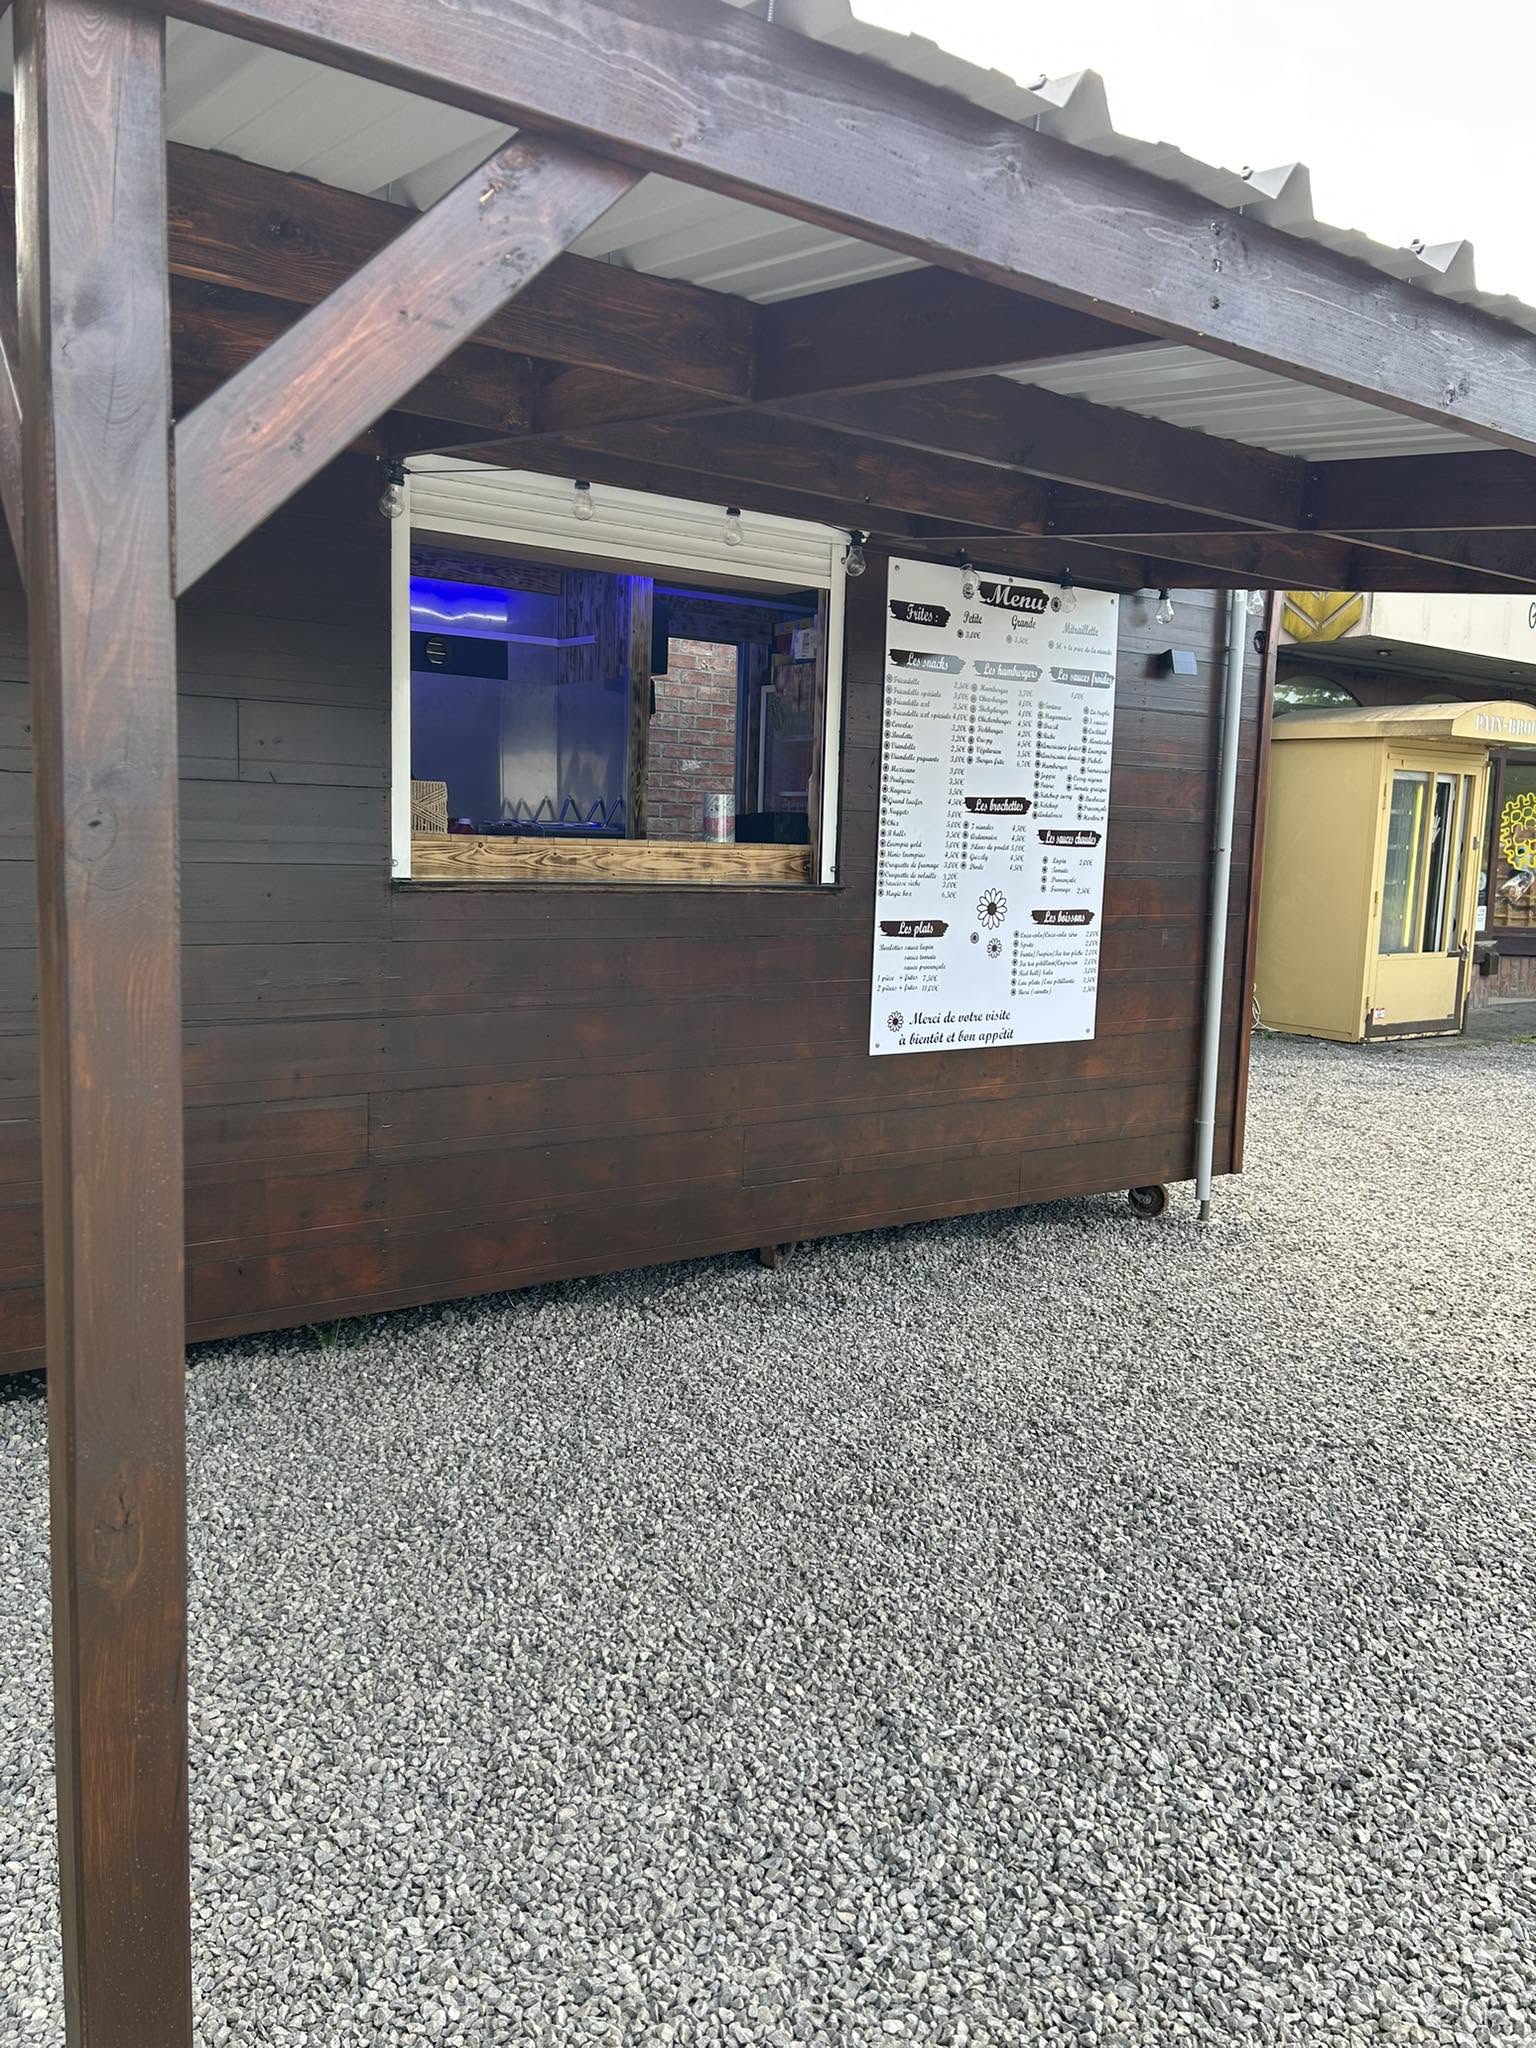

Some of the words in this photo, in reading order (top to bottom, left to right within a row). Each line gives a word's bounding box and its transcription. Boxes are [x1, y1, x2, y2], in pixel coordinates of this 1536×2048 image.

[987, 585, 1044, 610] Menu
[906, 604, 933, 622] Frites
[963, 611, 982, 624] Petite
[1011, 615, 1036, 631] Grande
[966, 631, 981, 639] 3,00€
[906, 653, 921, 667] Les
[922, 657, 948, 670] snacks
[983, 663, 996, 675] Les
[997, 664, 1039, 683] hamburgers
[1057, 670, 1069, 681] Les
[1070, 673, 1090, 683] sauces
[1091, 671, 1114, 687] froides
[890, 808, 909, 817] Nuggets
[975, 799, 988, 811] Les
[990, 799, 1023, 811] brochettes
[1045, 831, 1055, 844] Les
[1056, 836, 1074, 844] sauces
[1075, 831, 1098, 845] chaudes
[1044, 910, 1056, 923] Les
[1058, 911, 1085, 923] boissons
[898, 921, 912, 934] Les
[913, 921, 934, 938] plats
[909, 1012, 941, 1025] Merci
[943, 1011, 955, 1023] de
[958, 1012, 983, 1022] votre
[986, 1010, 1010, 1021] visite
[899, 1034, 906, 1046] à
[909, 1032, 943, 1045] bientôt
[946, 1033, 955, 1043] et
[958, 1030, 975, 1042] bon
[979, 1027, 1014, 1044] appétit
